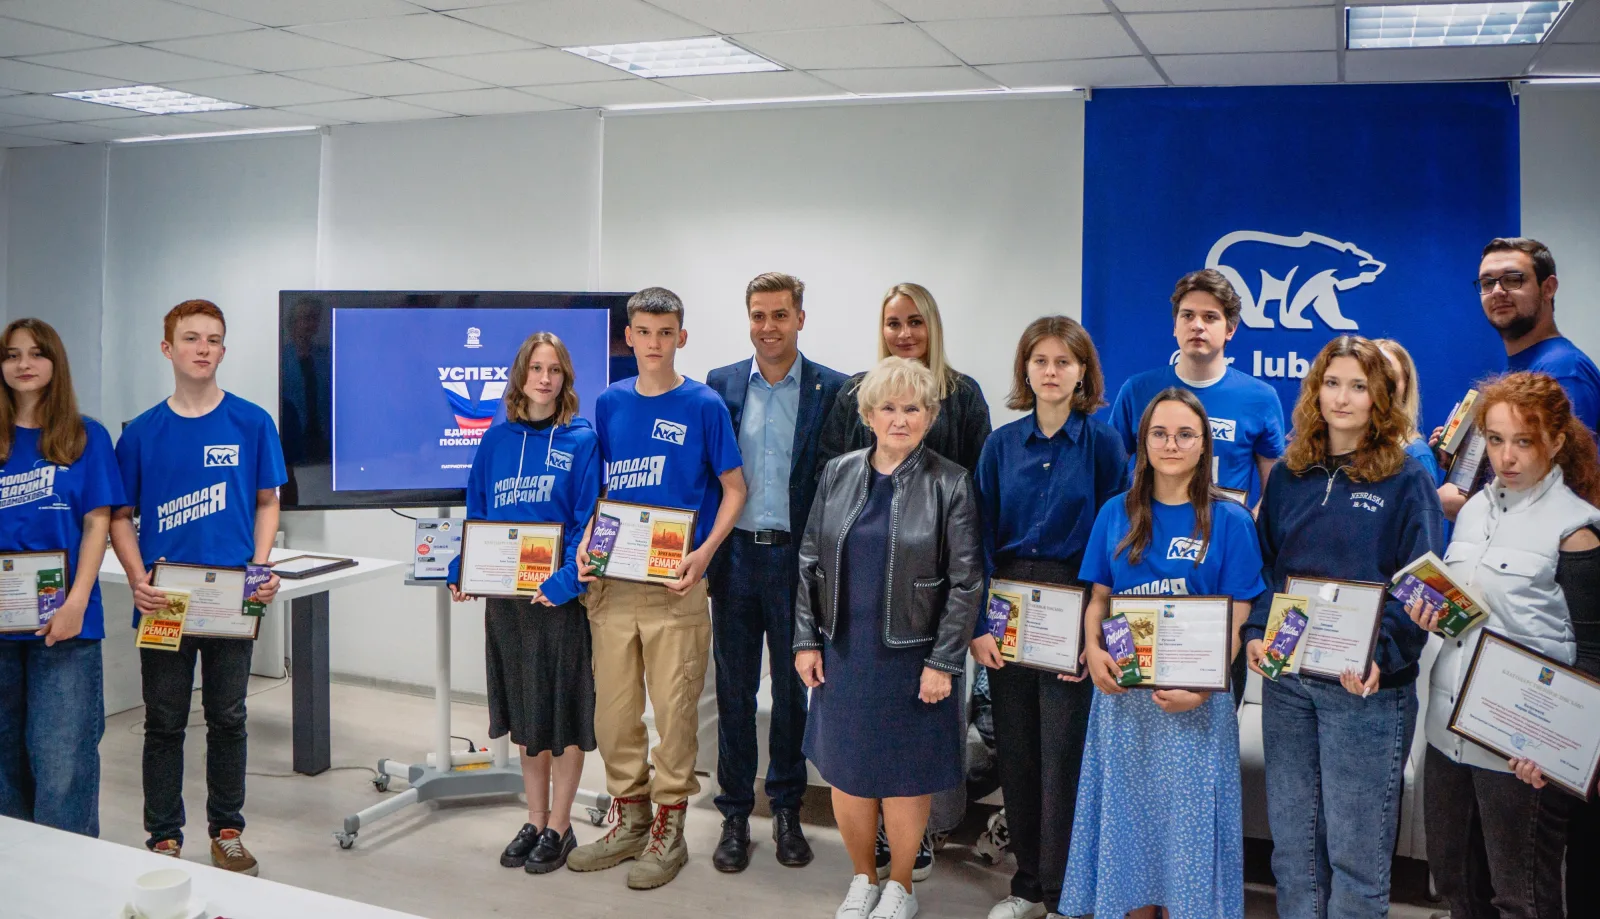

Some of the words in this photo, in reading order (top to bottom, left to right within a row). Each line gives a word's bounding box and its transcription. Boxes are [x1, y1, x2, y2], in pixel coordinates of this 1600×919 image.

[1253, 351, 1316, 378] lub
[438, 367, 508, 380] УСПЕХ
[609, 456, 666, 474] ЛОДАЯ
[0, 470, 55, 498] ВАРДИЯ
[608, 464, 665, 491] АРДИЯ
[0, 489, 49, 507] ОДМОСКОВЬЕ
[158, 482, 226, 518] МОЛОДАЯ
[494, 482, 555, 508] ГВАРДИЯ
[1350, 492, 1384, 507] NEBRASKA
[158, 490, 226, 533] ГВАРДИЯ
[594, 526, 616, 536] Milka
[649, 557, 681, 568] РЕМАРК
[246, 575, 270, 585] Milka
[518, 571, 550, 582] РЕМАРК
[987, 609, 1008, 620] Milka
[144, 626, 180, 637] РЕМАРК
[1106, 627, 1130, 646] Milka
[1280, 622, 1300, 636] Milka
